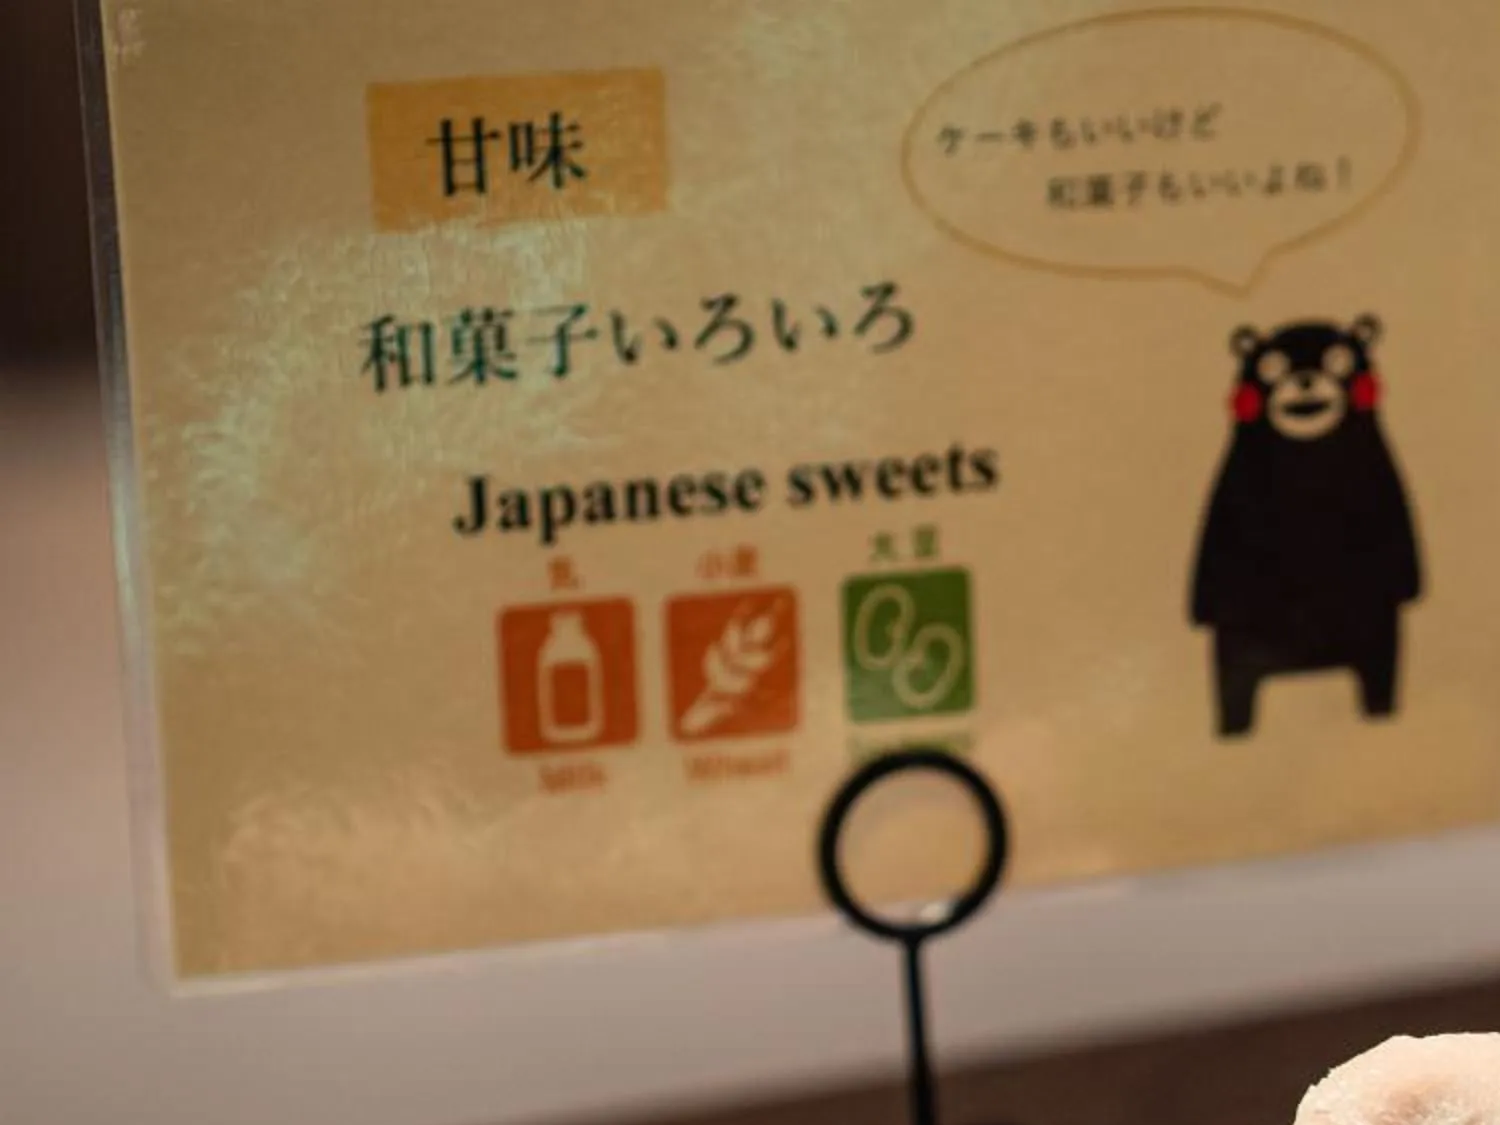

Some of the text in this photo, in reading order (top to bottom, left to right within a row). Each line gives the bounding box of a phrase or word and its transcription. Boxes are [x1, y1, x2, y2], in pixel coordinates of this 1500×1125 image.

[425, 111, 588, 197] 甘味
[360, 281, 915, 393] 和菓子いろいろ
[452, 443, 1000, 546] Japanese sweets
